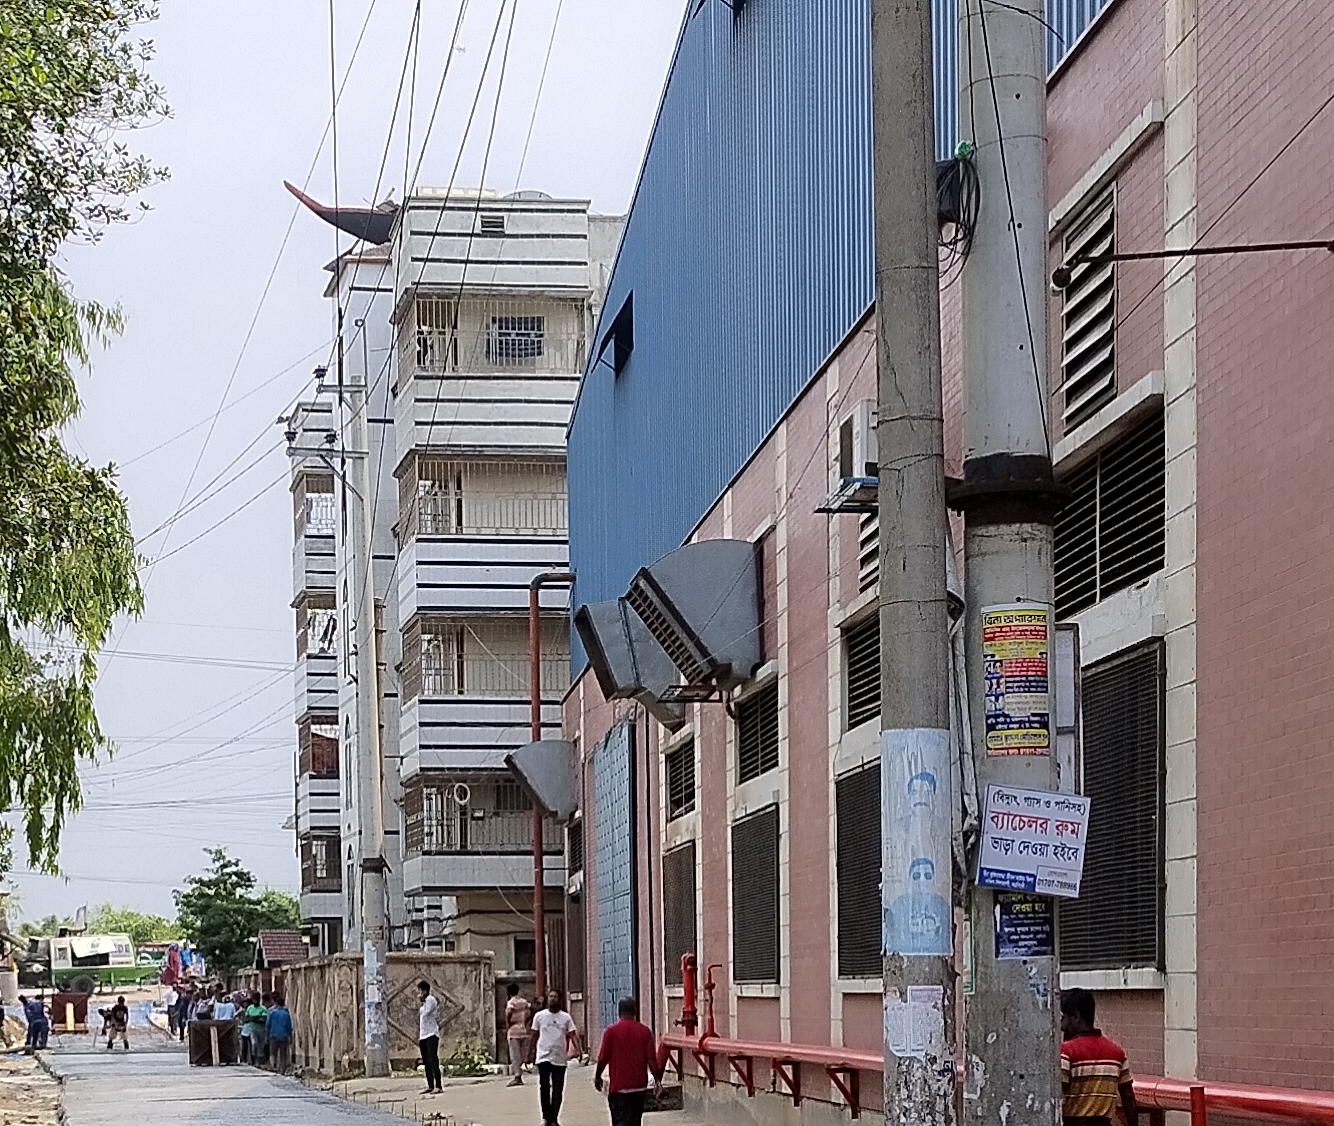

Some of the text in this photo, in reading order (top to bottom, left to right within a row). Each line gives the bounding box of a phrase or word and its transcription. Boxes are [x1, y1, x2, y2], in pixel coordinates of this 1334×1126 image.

[1044, 799, 1051, 809] ও
[990, 810, 1082, 839] ব্যাচেলর রুম
[990, 836, 1080, 862] ভাড়া দেওয়া হইবে
